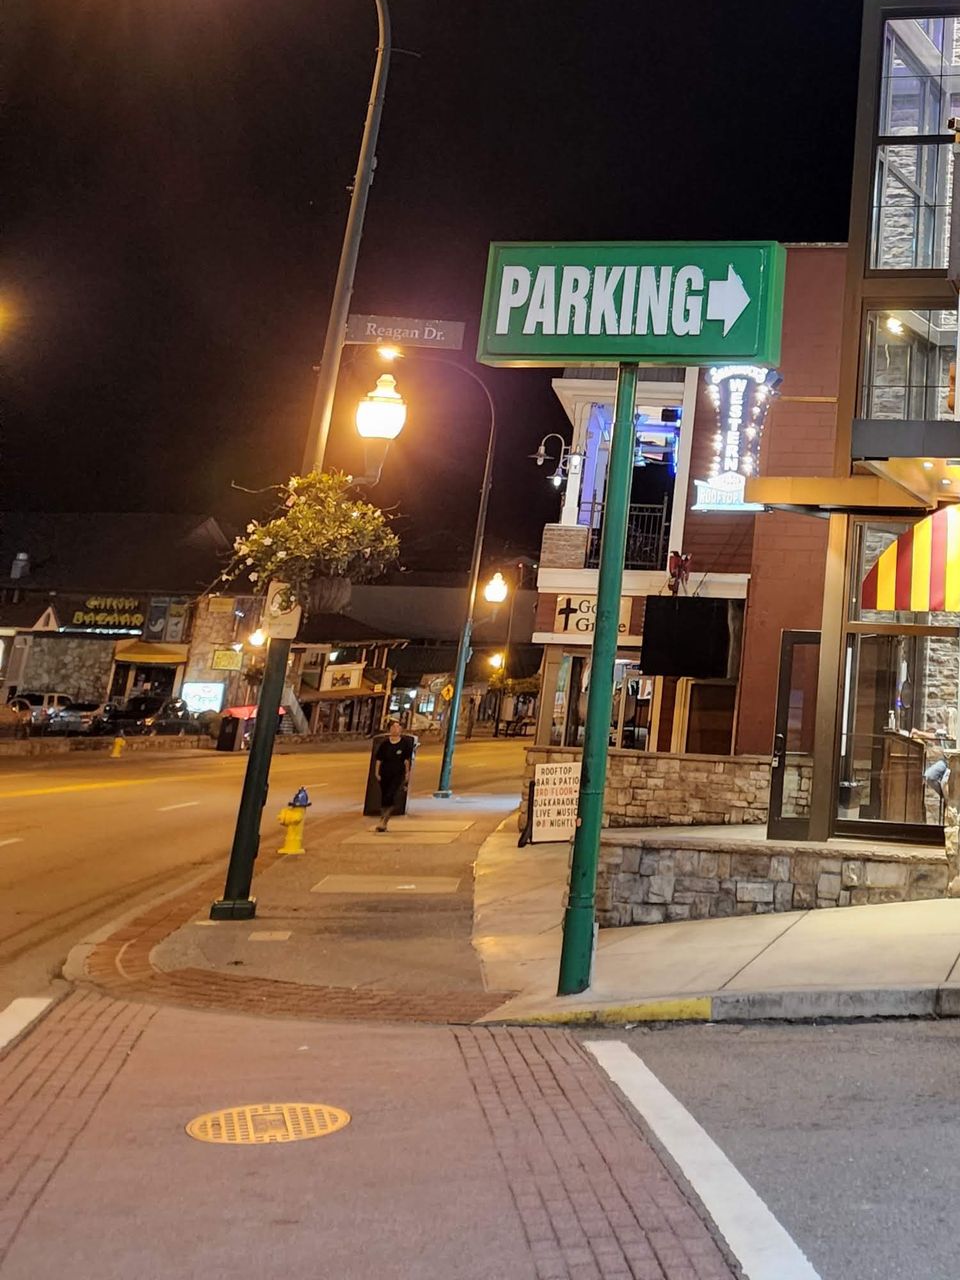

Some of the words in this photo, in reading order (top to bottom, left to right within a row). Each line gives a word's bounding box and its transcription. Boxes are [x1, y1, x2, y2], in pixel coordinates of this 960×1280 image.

[495, 264, 704, 337] PARKING
[365, 322, 419, 341] Reagan
[423, 326, 445, 341] Dr.
[724, 378, 747, 471] WESTERN
[72, 611, 145, 627] BAZAAR
[541, 767, 572, 775] ROOFTOP
[536, 778, 549, 786] BAR
[553, 777, 557, 786] &
[558, 776, 579, 785] PATIO
[535, 787, 549, 797] 3RD
[534, 798, 578, 807] DJ&KARAOKE
[535, 809, 551, 817] LIVE
[556, 807, 577, 817] MUSIC
[549, 818, 576, 827] NIGHTL
